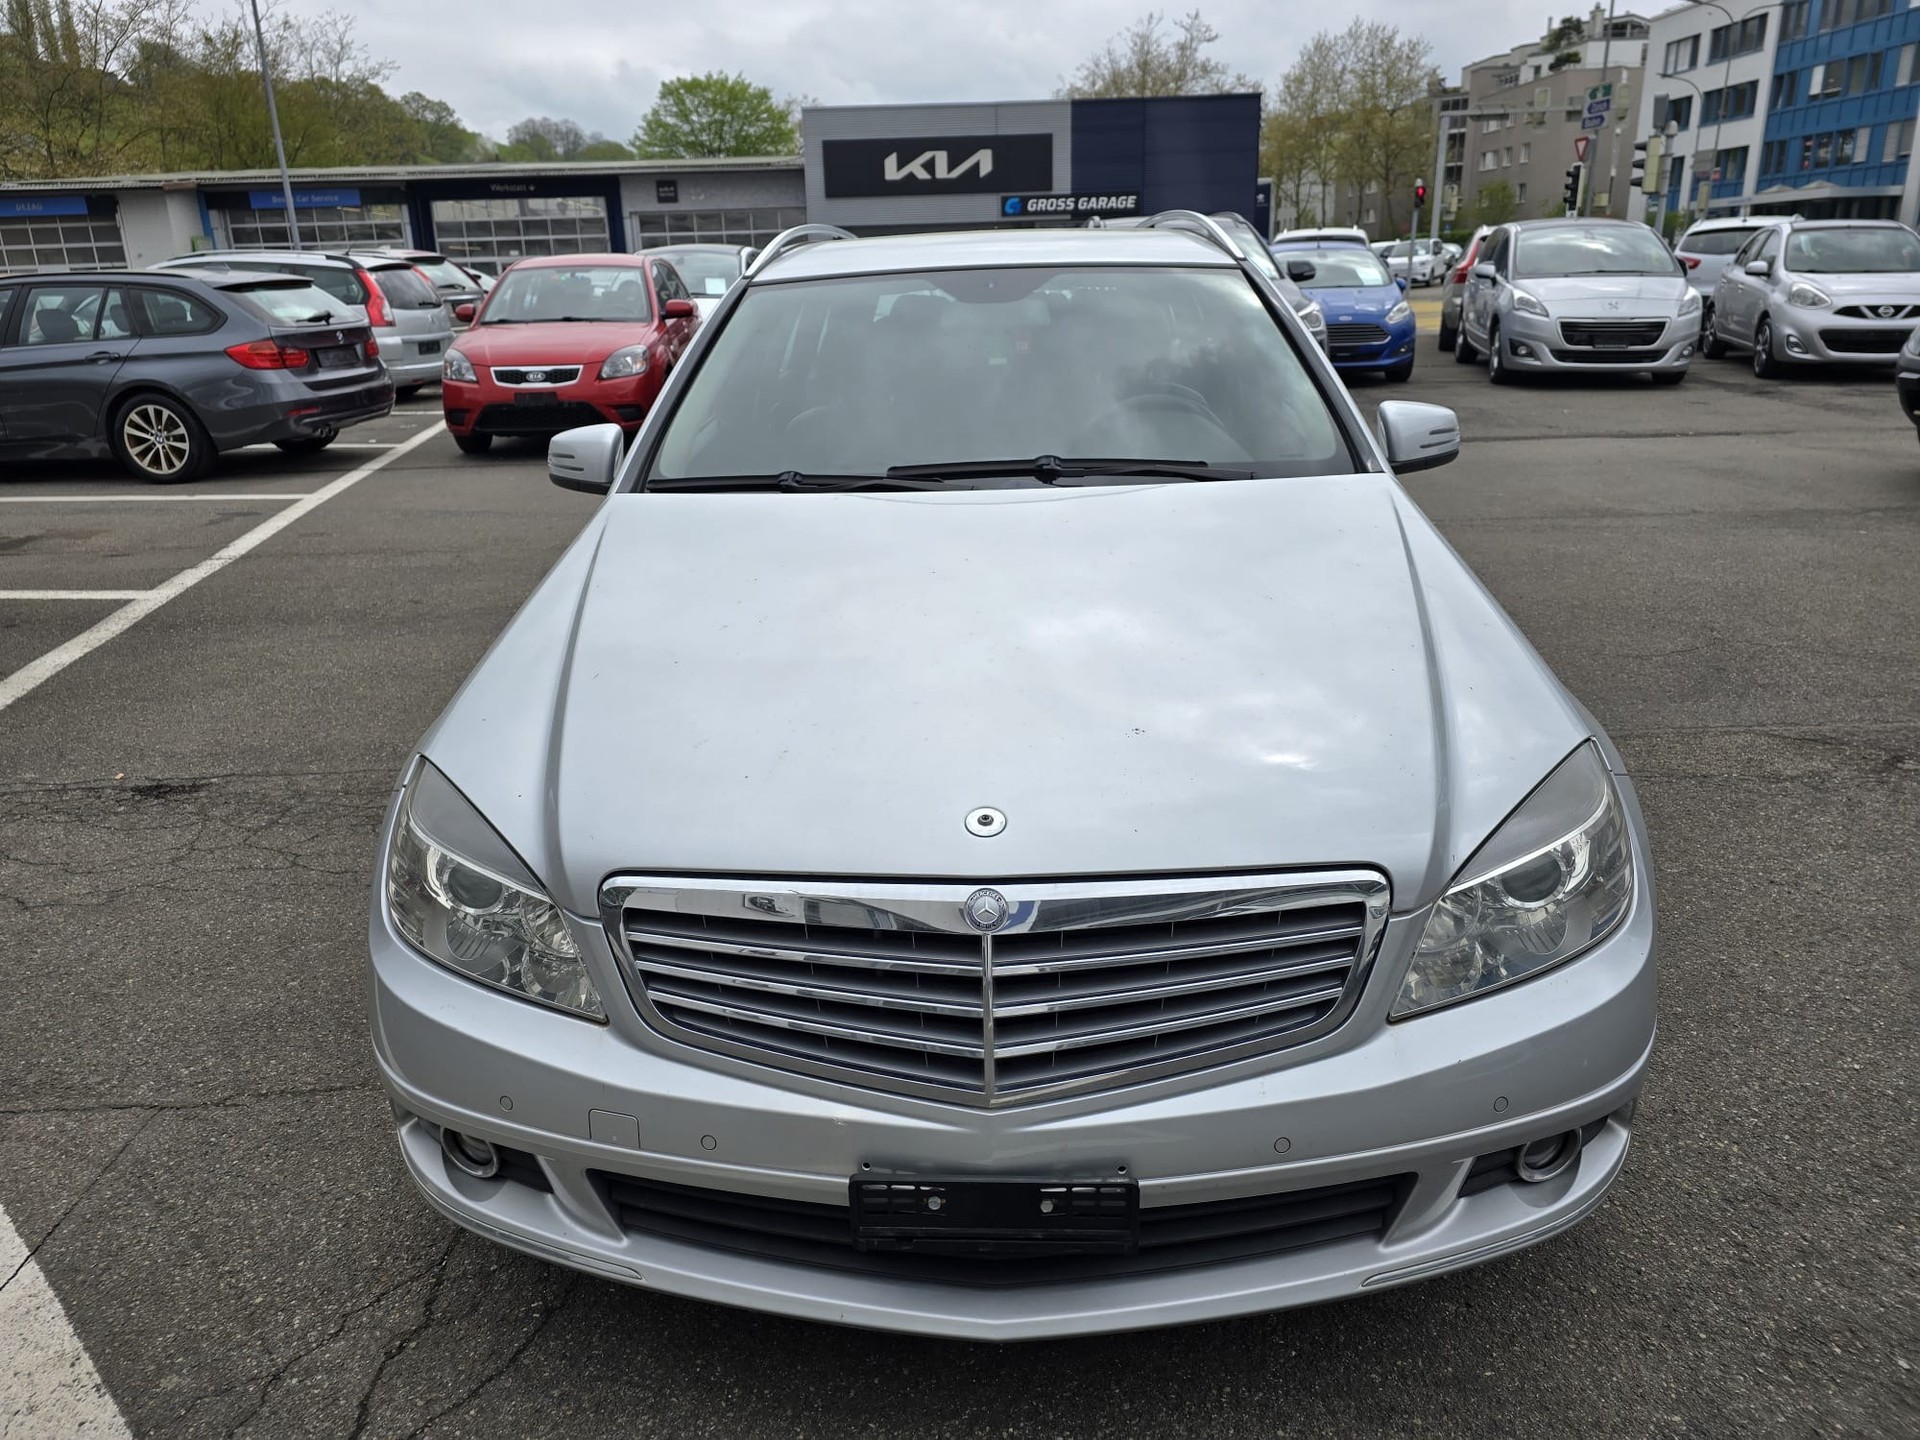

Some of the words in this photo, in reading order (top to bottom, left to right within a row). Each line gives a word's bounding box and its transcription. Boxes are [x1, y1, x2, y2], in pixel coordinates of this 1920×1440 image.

[884, 149, 993, 180] KIA
[311, 194, 339, 202] Service
[1027, 198, 1075, 212] GROSS
[1077, 195, 1137, 210] GARAGE
[970, 890, 1002, 902] MERCEDES
